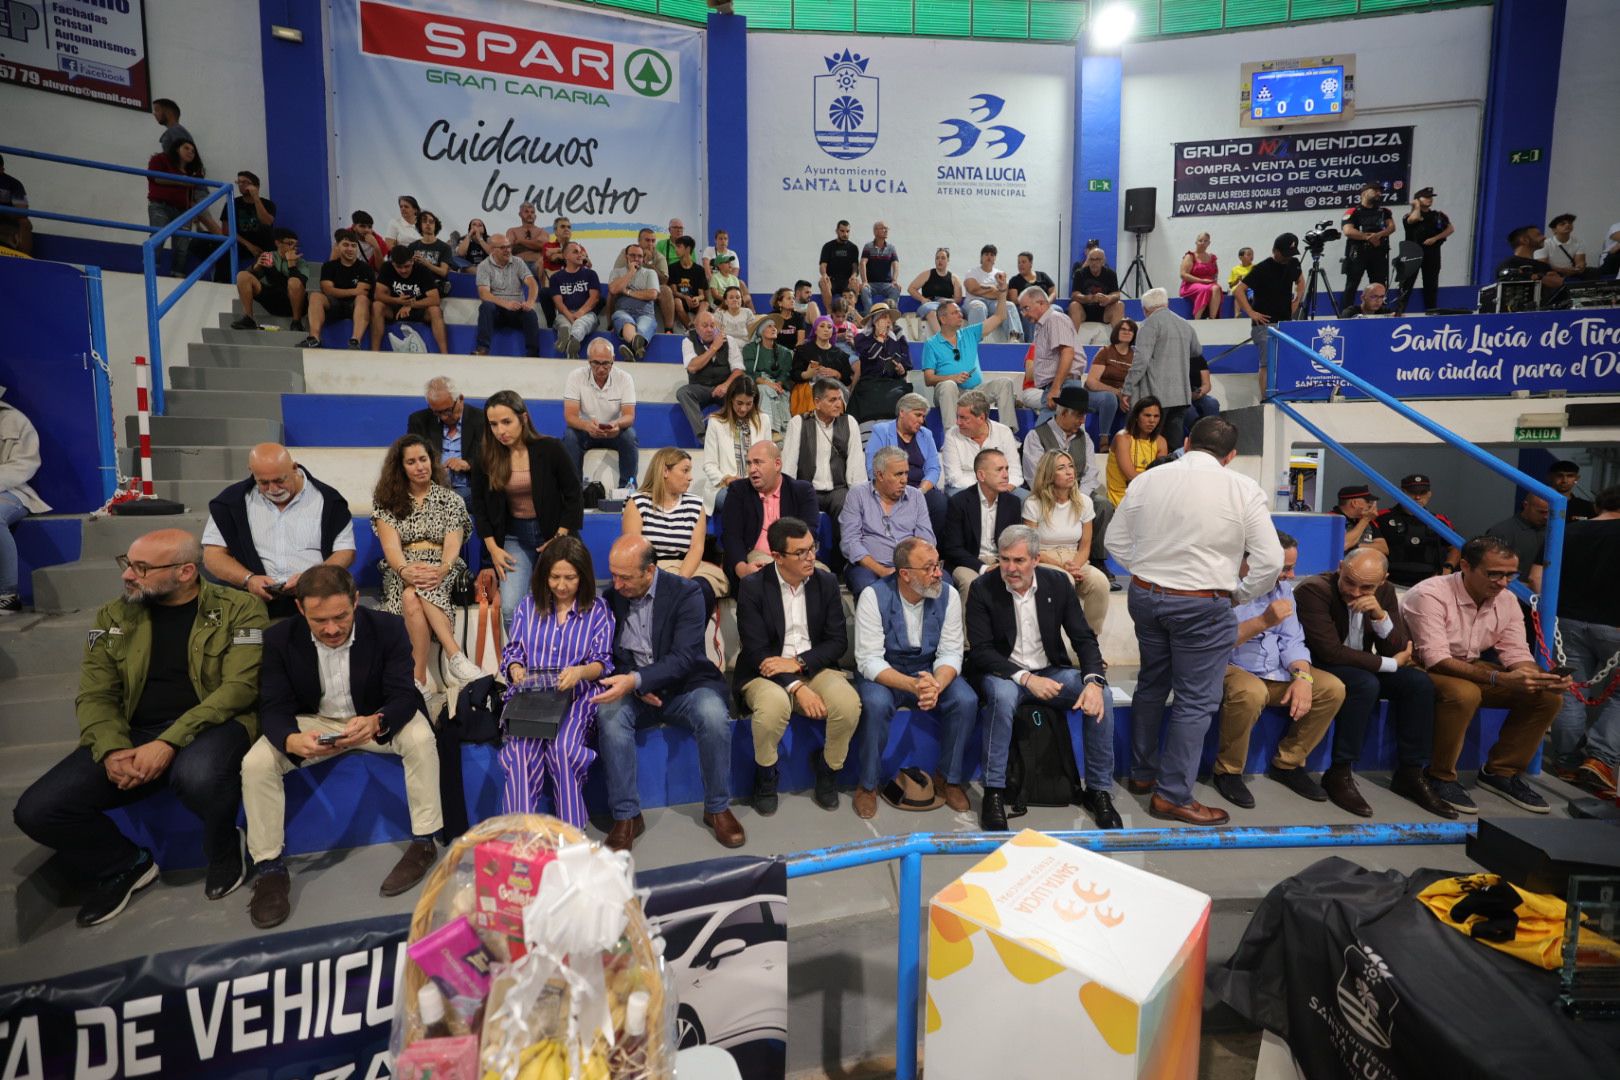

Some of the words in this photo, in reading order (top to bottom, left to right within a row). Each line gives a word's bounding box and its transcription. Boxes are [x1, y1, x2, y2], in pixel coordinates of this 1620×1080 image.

[53, 2, 108, 25] Fachadas
[54, 16, 93, 33] Cristal
[55, 28, 137, 57] Automatismos
[56, 41, 79, 55] PVC
[424, 22, 609, 80] SPAR
[20, 69, 40, 85] 79
[426, 69, 497, 91] GRAN
[504, 80, 610, 107] CANARIA
[1277, 101, 1287, 114] 0
[1304, 98, 1314, 112] 0
[422, 118, 598, 167] Cuidamos
[1183, 143, 1253, 159] GRUPO
[1296, 132, 1403, 152] MENDOZA
[804, 164, 887, 176] Ayuntamiento
[1184, 163, 1242, 175] COMPRA
[1252, 159, 1295, 171] VENTA
[1298, 158, 1317, 168] DE
[1320, 152, 1400, 167] VEHÍCULOS
[937, 165, 983, 180] SANTA
[986, 167, 1026, 181] LUCIA
[1209, 172, 1284, 185] SERVICIO
[1288, 171, 1310, 181] DE
[1314, 168, 1363, 179] GRUA
[481, 169, 519, 213] lo
[524, 177, 647, 216] nuestro
[782, 177, 841, 191] SANTA
[848, 178, 908, 193] LUCIA
[937, 187, 973, 195] ATENEO
[976, 188, 1026, 197] MUNICIPAL
[1208, 191, 1217, 200] EN
[1217, 190, 1229, 199] LAS
[1230, 189, 1250, 199] REDES
[1251, 188, 1281, 198] SOCIALES
[1177, 204, 1195, 213] AV/
[1197, 201, 1253, 212] CANARIAS
[1269, 199, 1288, 208] 412
[1318, 196, 1342, 206] 828
[560, 281, 589, 295] BEAST
[1390, 323, 1467, 353] Santa
[1467, 324, 1533, 356] Lucía
[1540, 322, 1573, 348] de
[1396, 366, 1434, 381] una
[1438, 358, 1504, 381] ciudad
[1512, 361, 1567, 385] para
[1570, 355, 1588, 378] el
[1518, 427, 1558, 440] SALIDA
[74, 994, 163, 1080] DE
[186, 941, 409, 1061] VEHICU
